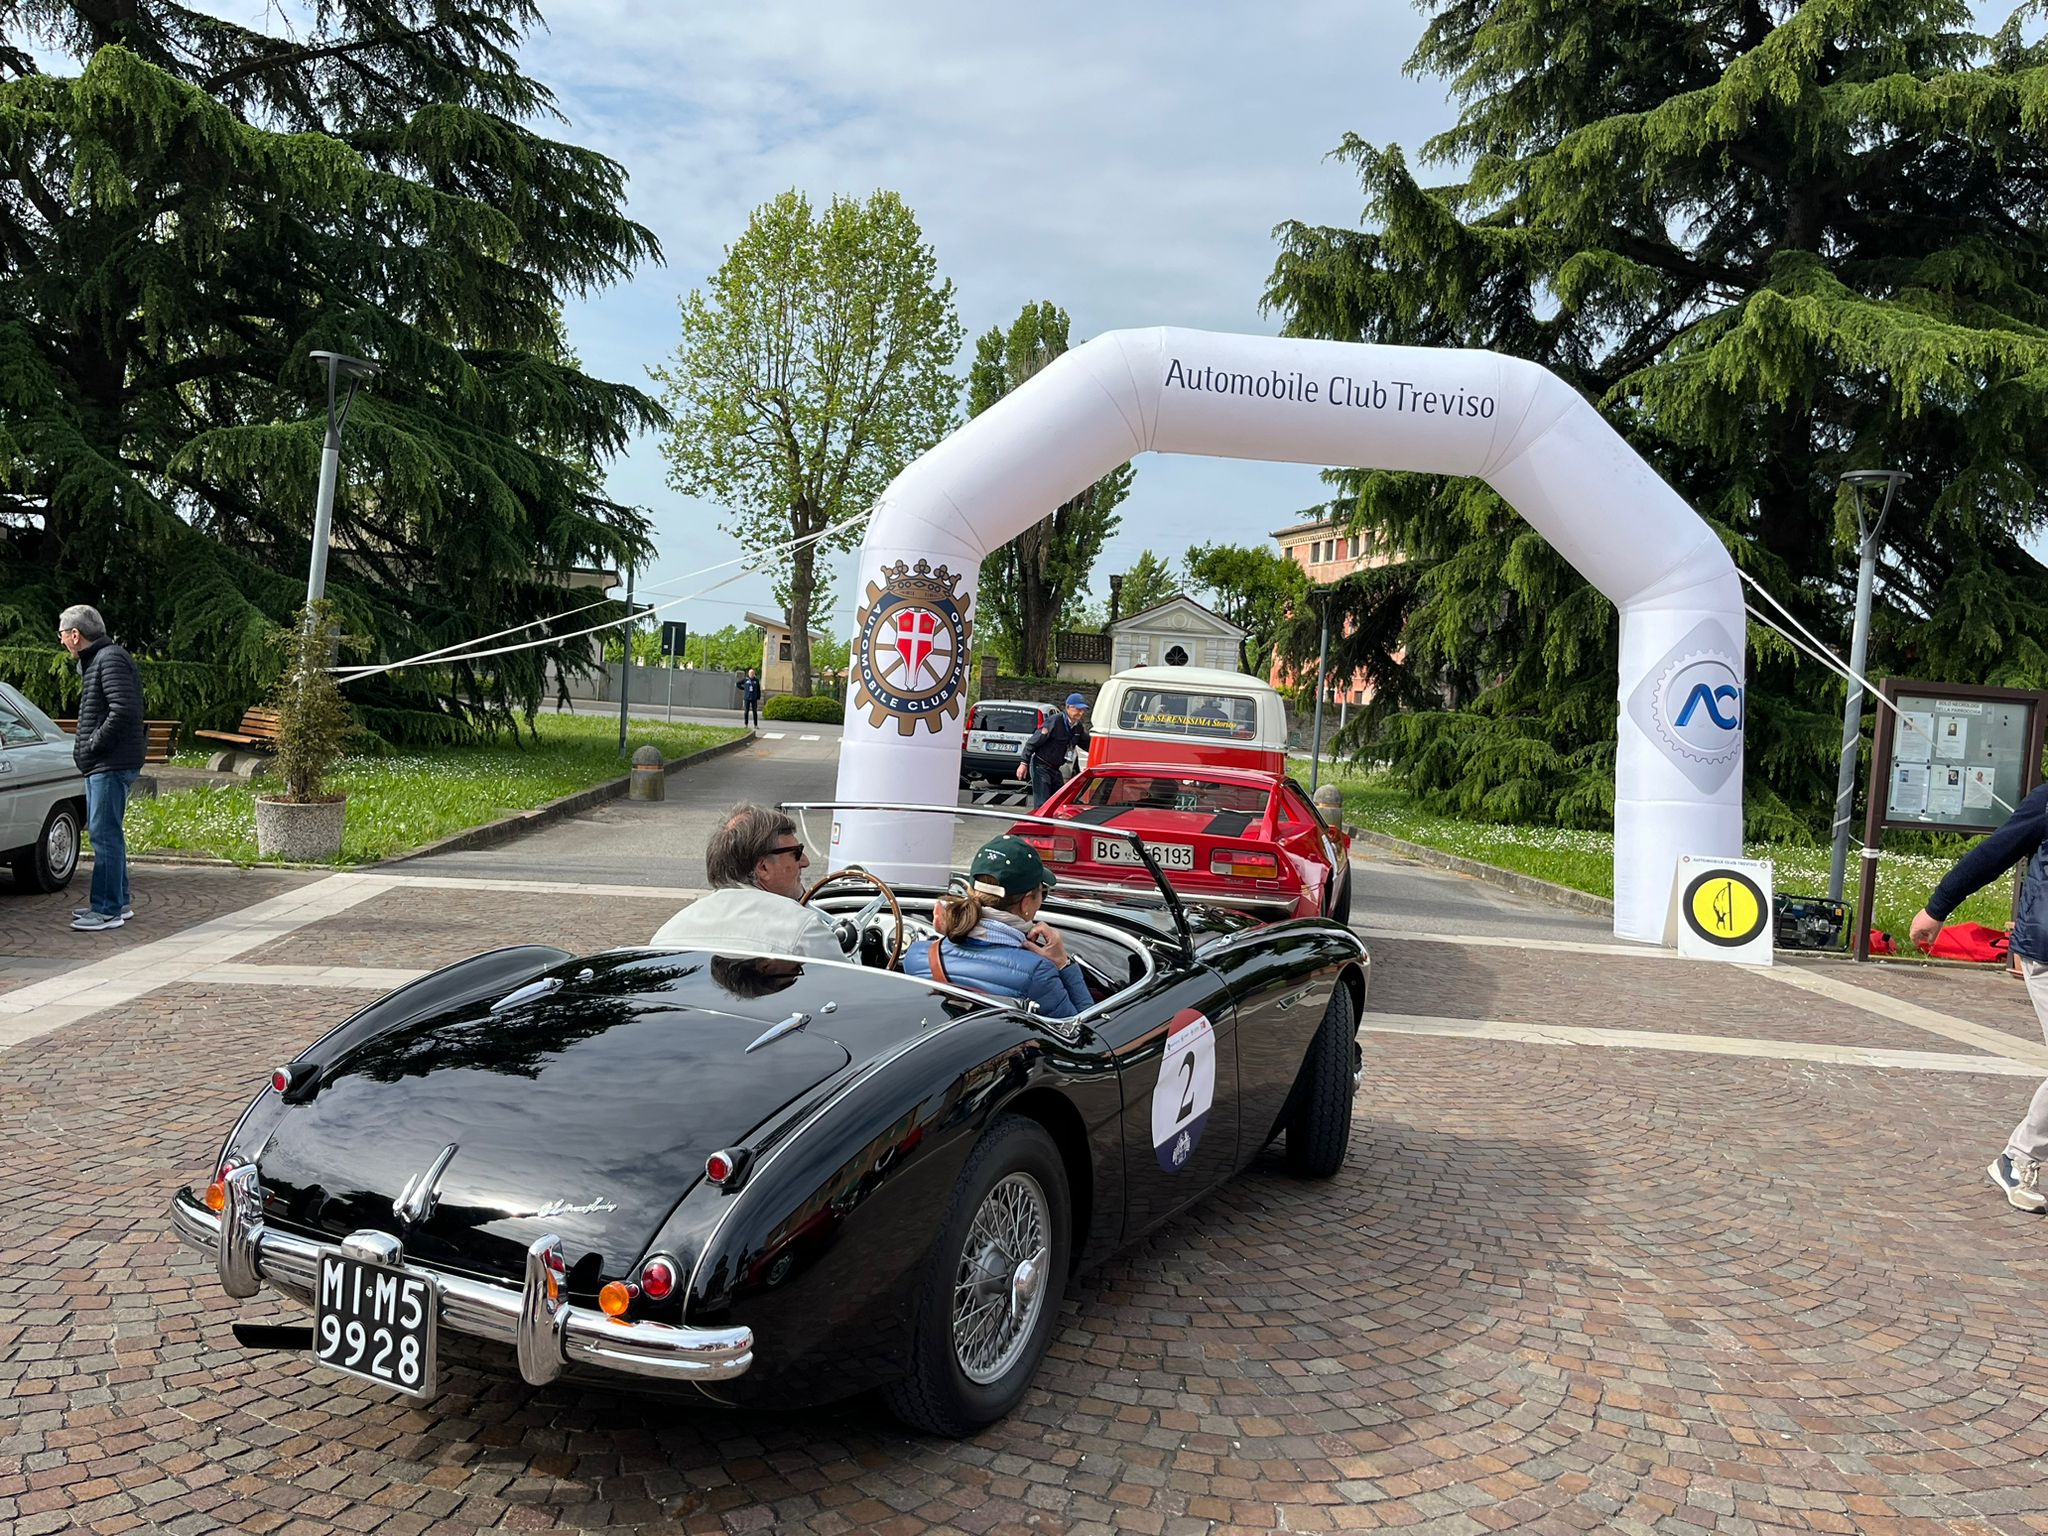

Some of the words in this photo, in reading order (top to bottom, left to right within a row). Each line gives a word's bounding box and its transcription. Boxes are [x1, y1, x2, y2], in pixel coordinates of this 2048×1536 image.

[1165, 358, 1319, 403] Automobile
[1329, 376, 1387, 409] Club
[1391, 381, 1495, 419] Treviso
[861, 604, 898, 708] AUTOMOBILE
[907, 692, 950, 710] CLUB
[950, 611, 964, 685] TREVISO
[1139, 713, 1155, 723] Club
[1155, 714, 1211, 727] SERENISSIMA
[1097, 841, 1120, 859] BG
[1132, 846, 1192, 865] 96193
[1176, 1051, 1195, 1124] 2
[320, 1313, 420, 1384] 9928
